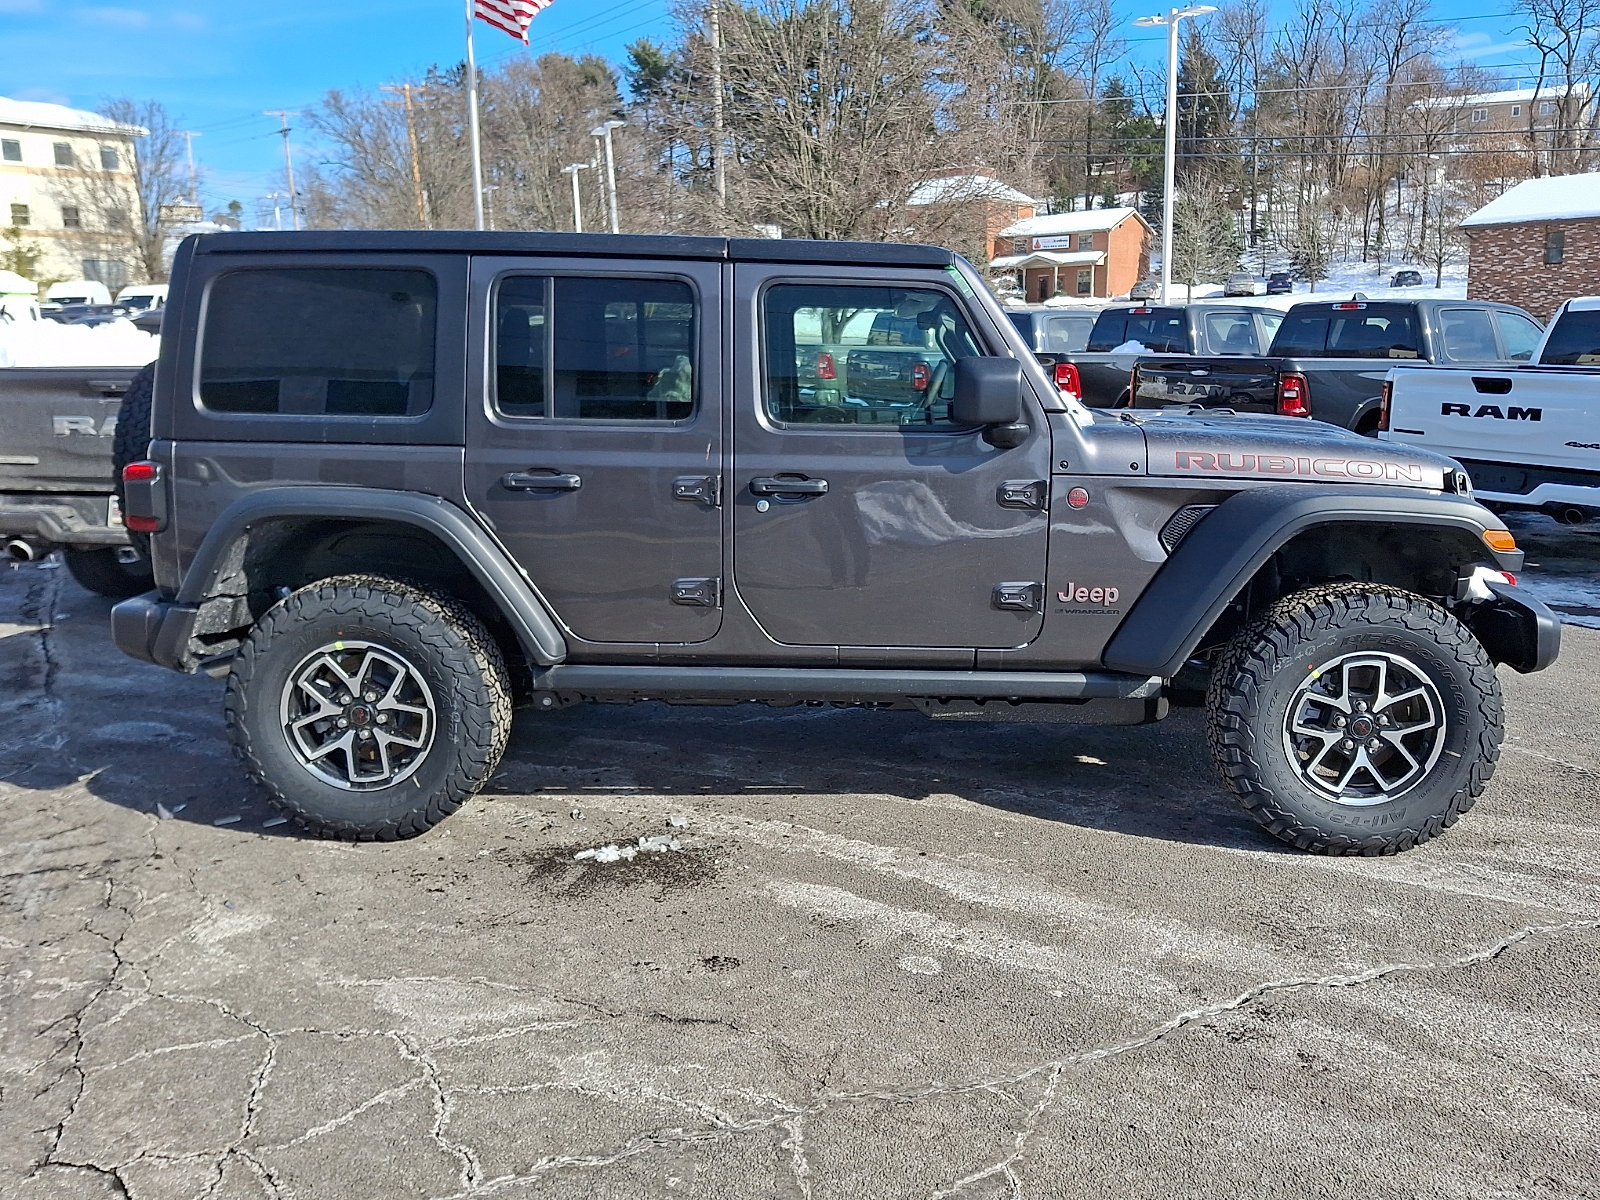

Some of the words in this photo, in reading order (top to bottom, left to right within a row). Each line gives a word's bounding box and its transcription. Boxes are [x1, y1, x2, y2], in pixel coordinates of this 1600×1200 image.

[1166, 384, 1231, 397] RAM
[1440, 402, 1543, 422] RAM
[1175, 451, 1422, 482] RUBICON
[1057, 582, 1119, 607] Jeep
